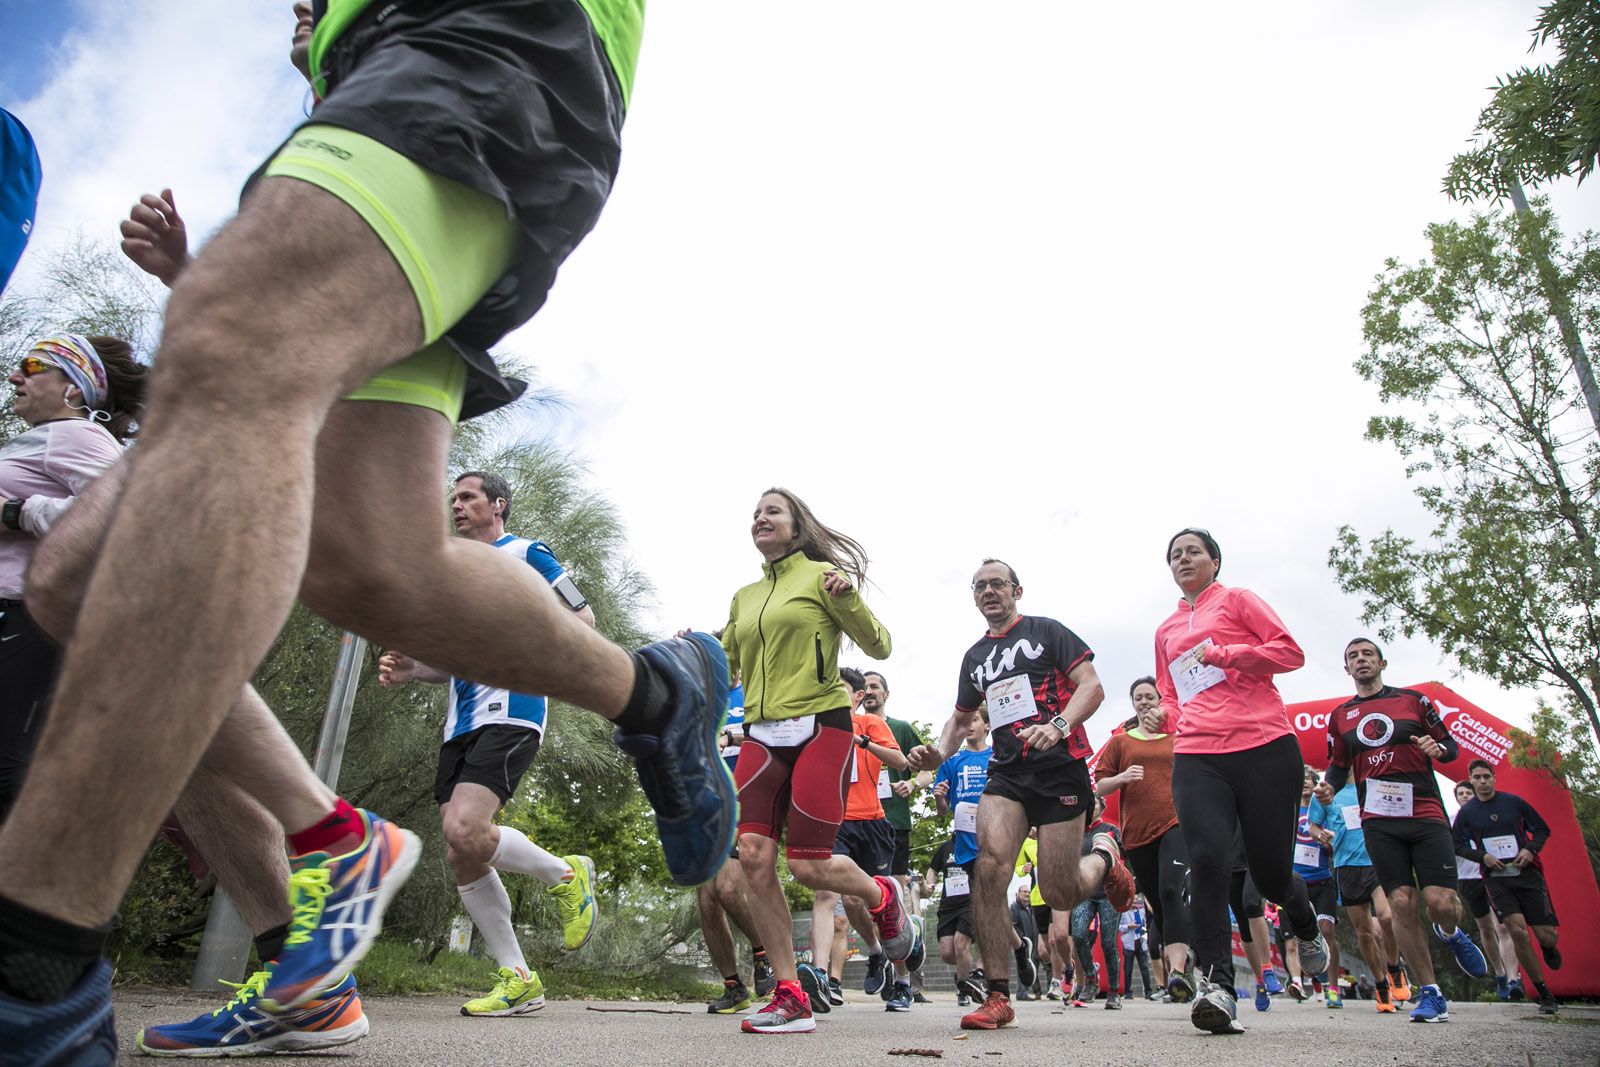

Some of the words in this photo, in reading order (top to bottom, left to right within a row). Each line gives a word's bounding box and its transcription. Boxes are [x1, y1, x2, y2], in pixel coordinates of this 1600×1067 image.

[1189, 666, 1198, 676] 17
[999, 697, 1010, 706] 28
[1450, 720, 1507, 759] Occident
[1458, 713, 1514, 749] Catalana
[1368, 750, 1394, 767] 1967
